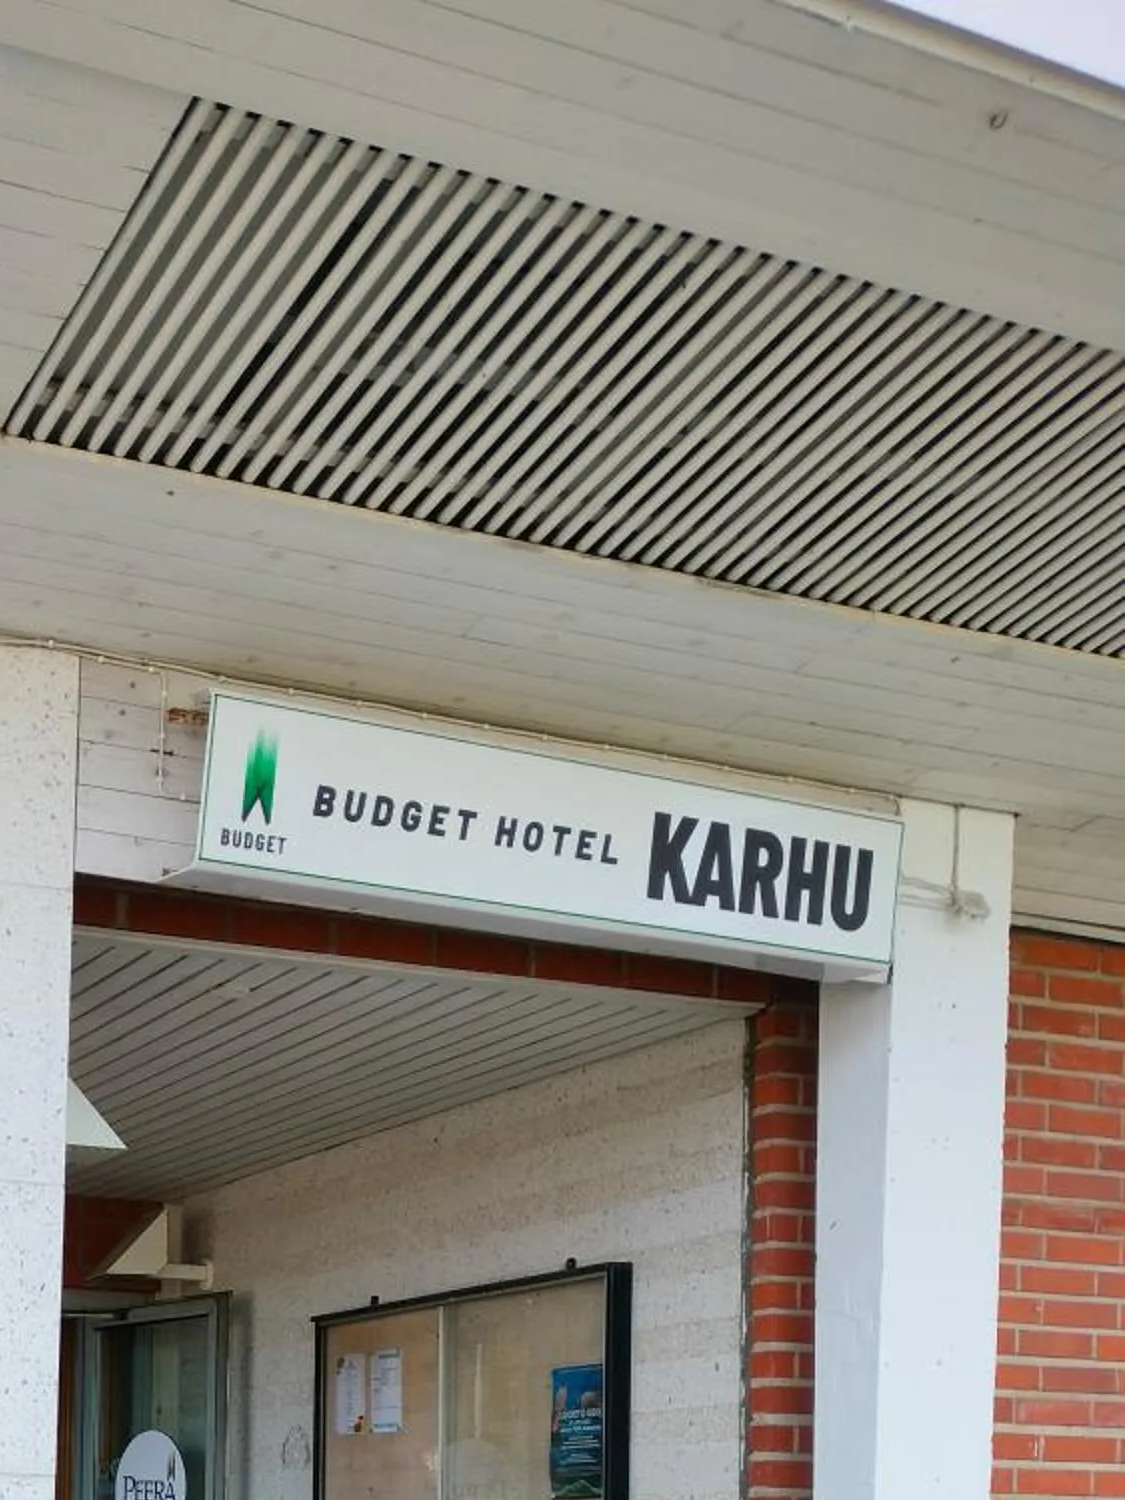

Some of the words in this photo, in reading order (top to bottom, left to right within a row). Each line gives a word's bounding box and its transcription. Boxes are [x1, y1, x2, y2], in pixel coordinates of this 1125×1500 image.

[220, 828, 288, 856] BUDGET
[312, 784, 478, 842] BUDGET
[494, 815, 620, 866] HOTEL
[646, 811, 875, 933] KARHU
